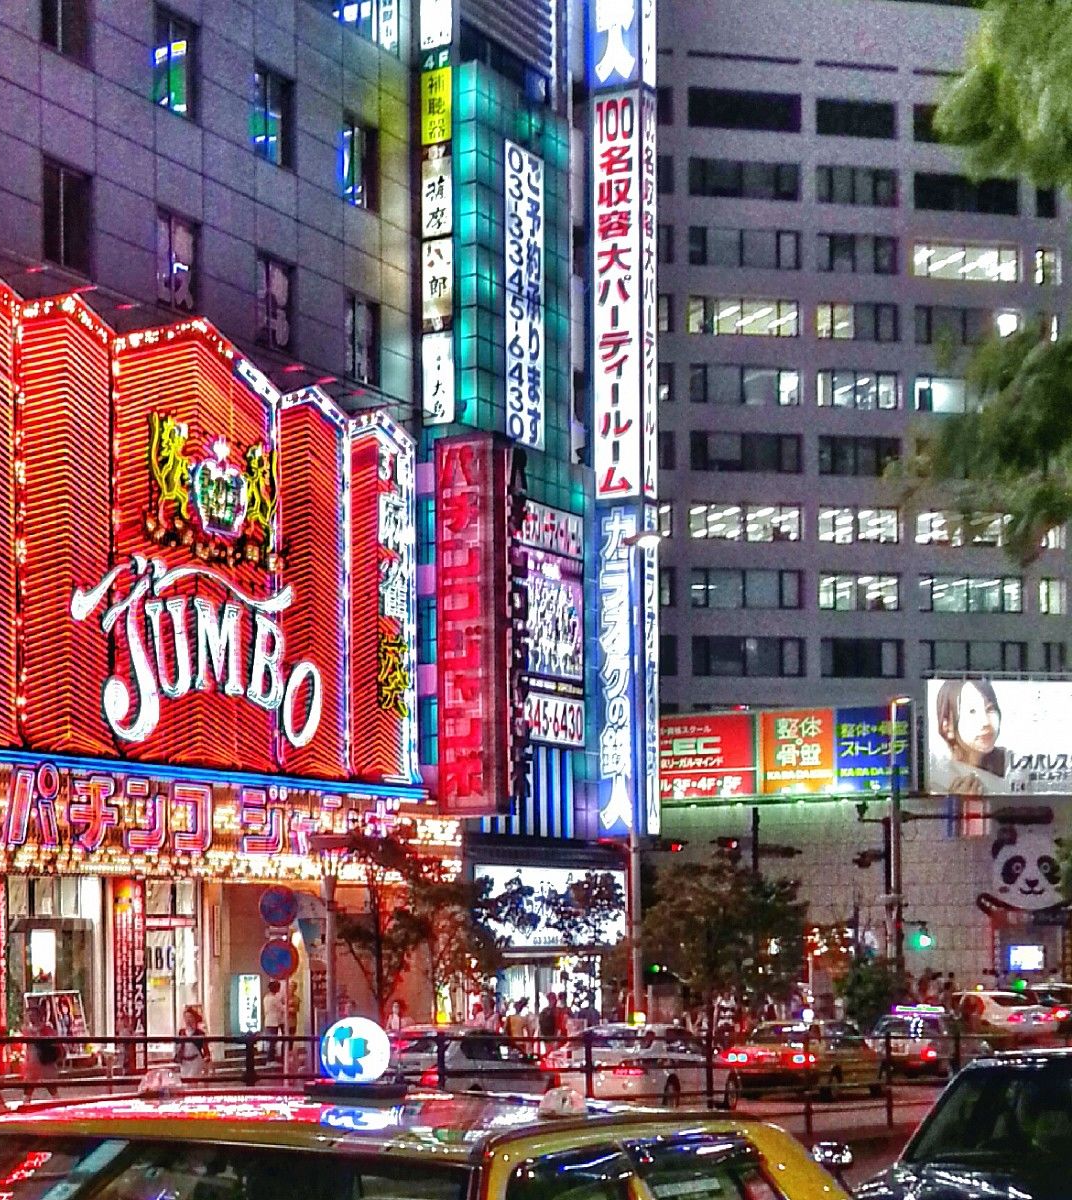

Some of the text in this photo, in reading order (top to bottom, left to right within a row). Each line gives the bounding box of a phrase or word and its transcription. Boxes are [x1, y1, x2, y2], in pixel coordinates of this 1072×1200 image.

[424, 51, 450, 69] 4F
[71, 555, 322, 748] JUMBO
[5, 760, 214, 857] パチンコ
